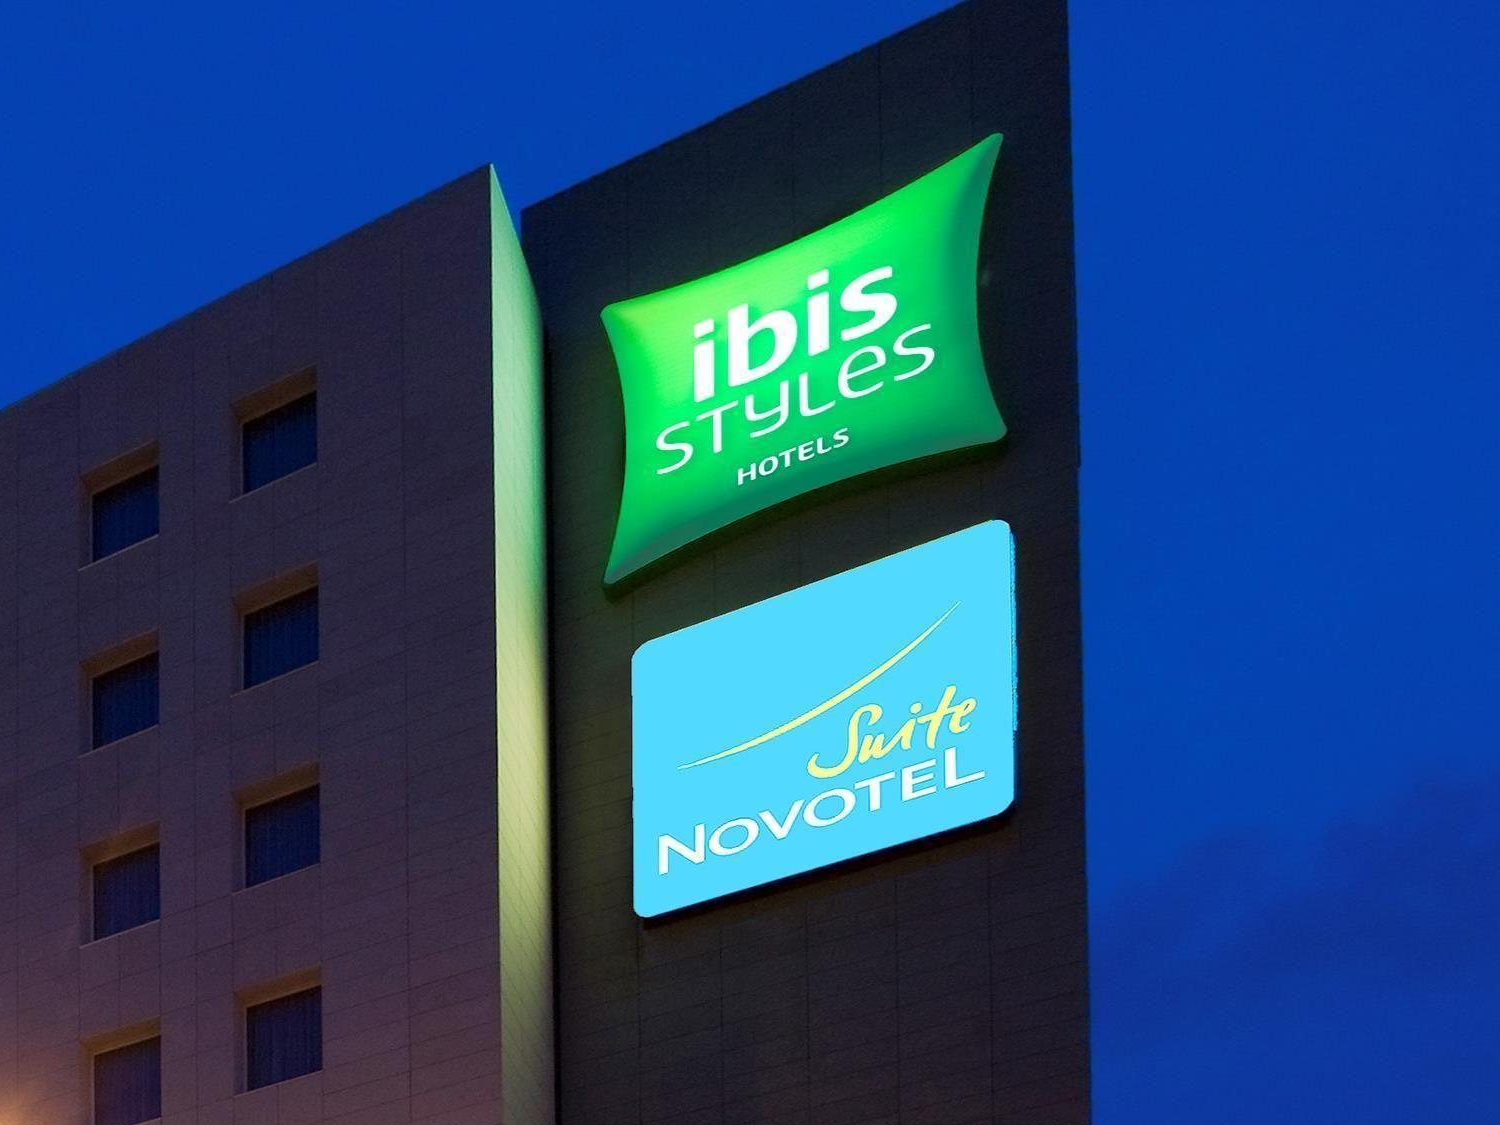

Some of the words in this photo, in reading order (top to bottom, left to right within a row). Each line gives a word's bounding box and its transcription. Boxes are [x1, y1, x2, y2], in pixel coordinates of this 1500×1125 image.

[693, 265, 898, 403] ibis
[736, 427, 850, 486] HOTELS
[806, 685, 977, 779] Suite
[658, 746, 986, 876] NOVOTEL
